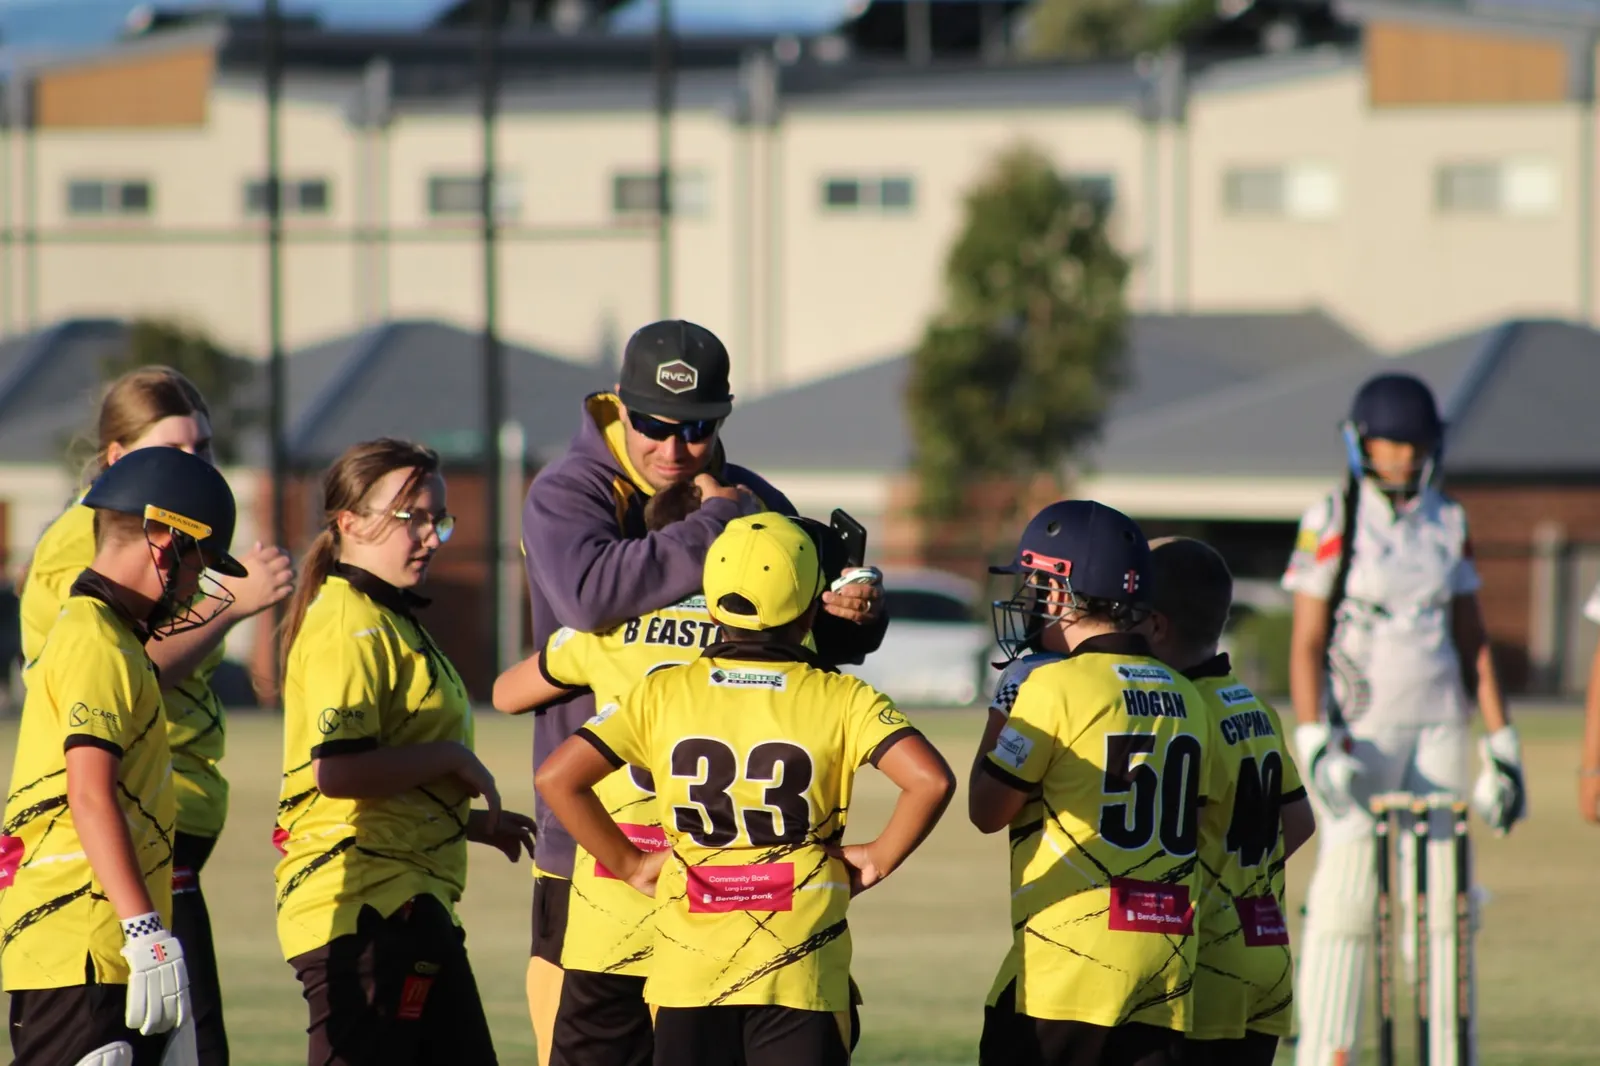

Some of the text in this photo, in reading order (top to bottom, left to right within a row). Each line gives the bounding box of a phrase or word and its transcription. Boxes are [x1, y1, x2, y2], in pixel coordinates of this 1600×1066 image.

[660, 370, 693, 383] RVCA
[624, 617, 641, 644] B
[1122, 689, 1187, 719] HOGAN
[92, 708, 119, 723] CARE
[671, 736, 813, 848] 33
[1099, 733, 1202, 857] 50
[708, 874, 770, 884] Community Bank
[715, 895, 750, 903] Bendigo
[1137, 912, 1183, 923] Bendigo Bank
